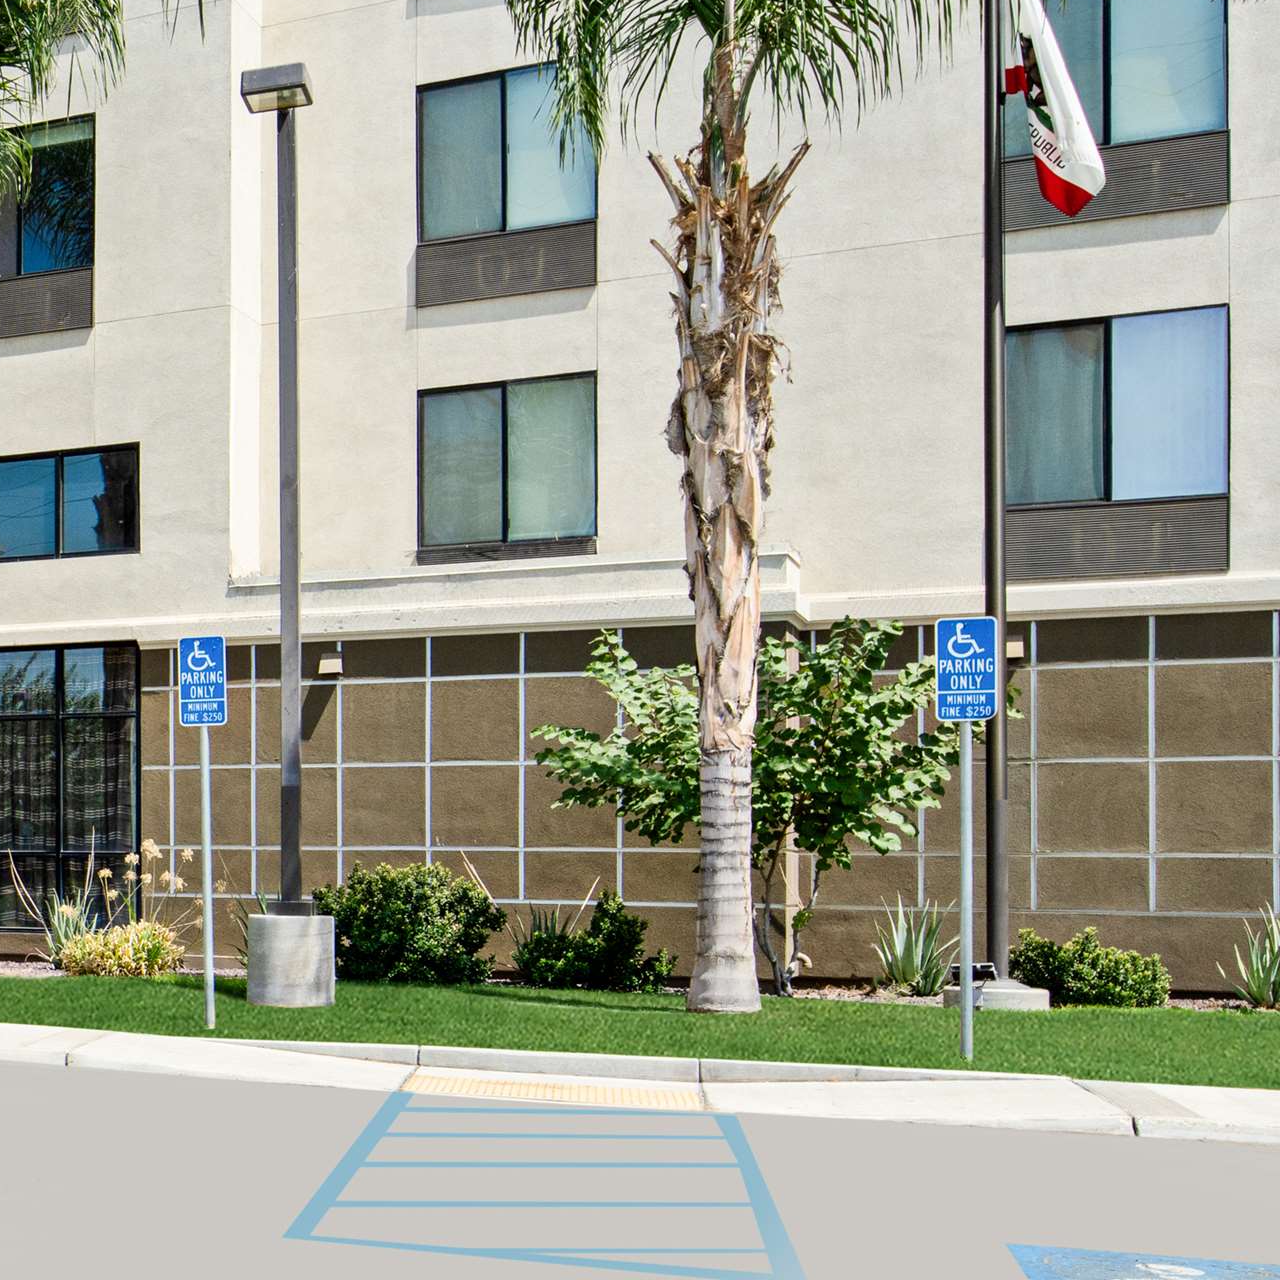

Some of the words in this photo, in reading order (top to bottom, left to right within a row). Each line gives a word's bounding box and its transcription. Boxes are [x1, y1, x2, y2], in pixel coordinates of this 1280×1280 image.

[939, 658, 993, 674] PARKING
[181, 671, 223, 685] PARKING
[950, 674, 983, 690] ONLY
[190, 685, 215, 699] ONLY
[946, 694, 986, 705] MINIMUM
[187, 702, 218, 712] MINIMUM
[941, 706, 960, 717] FINE
[965, 705, 992, 717] $250
[183, 712, 199, 722] FINE
[202, 712, 223, 722] $250
